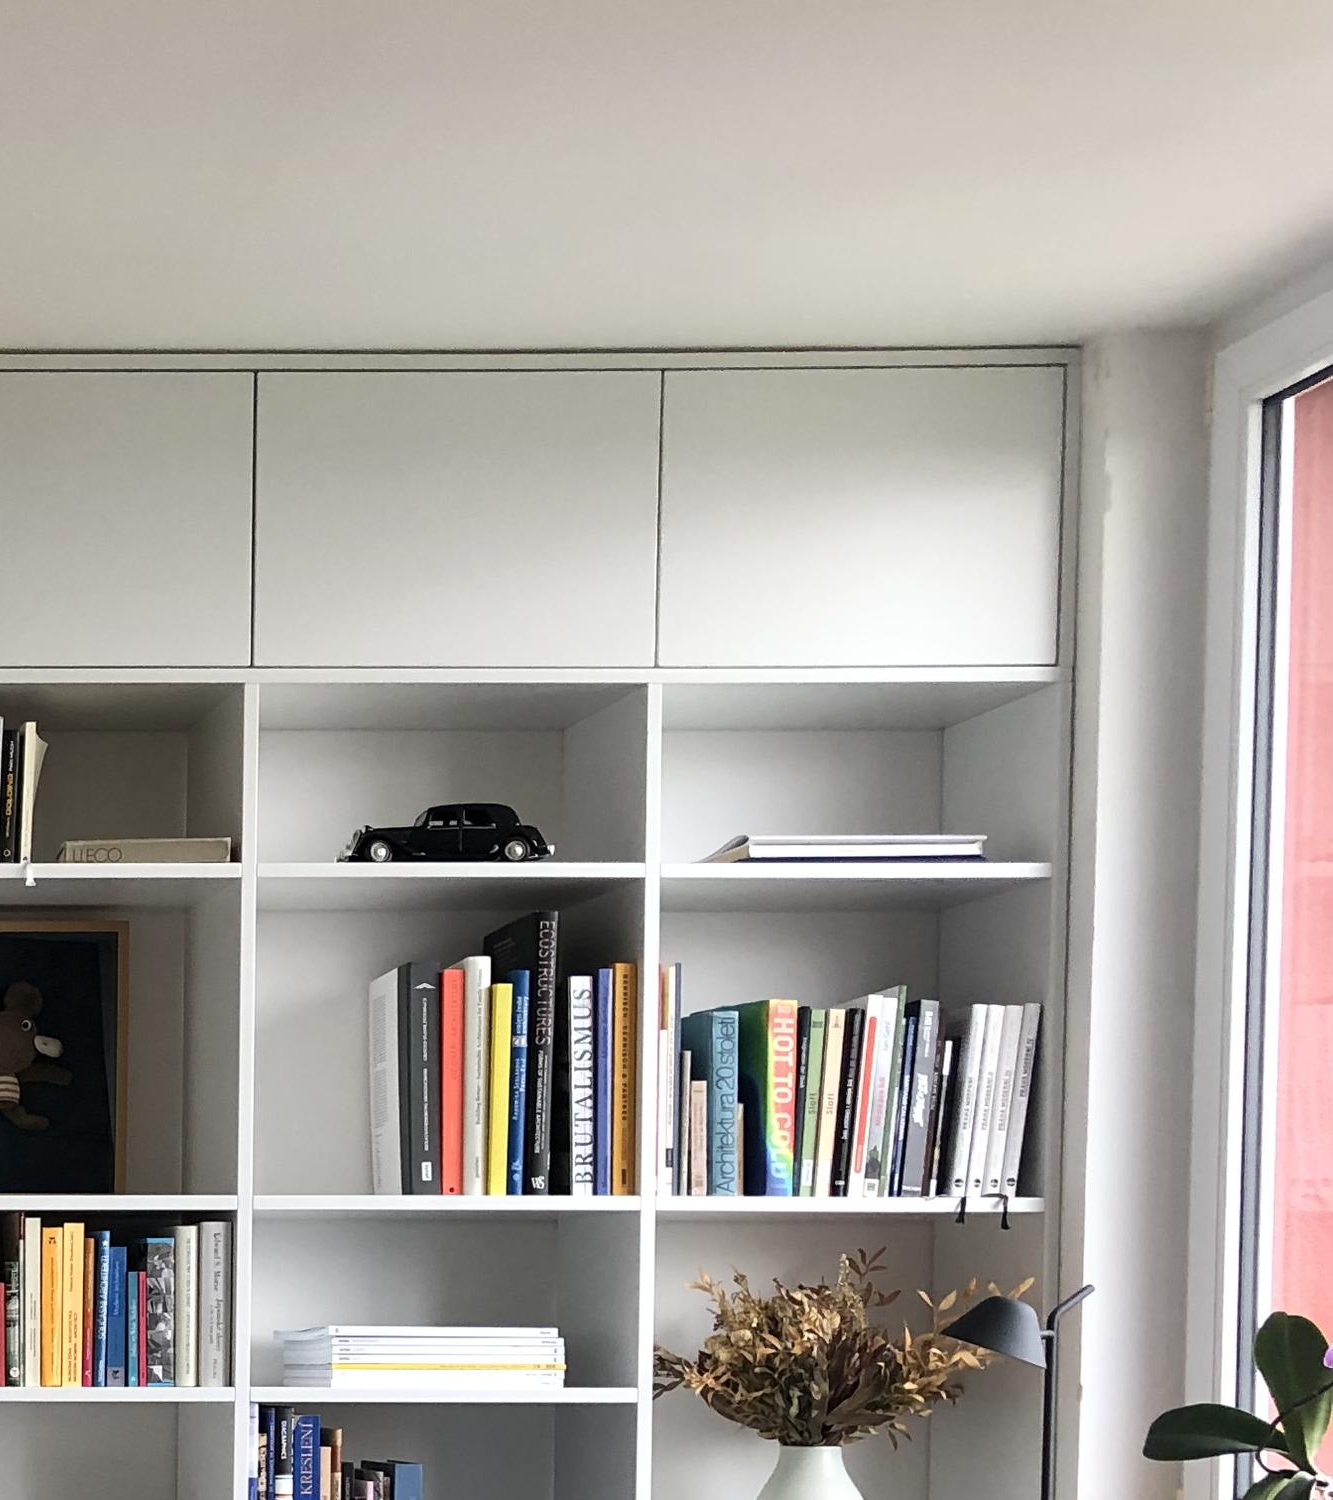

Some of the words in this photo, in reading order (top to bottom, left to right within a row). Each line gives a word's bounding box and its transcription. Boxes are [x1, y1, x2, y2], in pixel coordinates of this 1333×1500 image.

[535, 921, 556, 1045] ECOSTRUCTURES
[717, 1017, 736, 1065] století
[773, 1017, 794, 1067] HOT
[1022, 1046, 1031, 1074] MODERNÍ
[572, 989, 593, 1184] BRUTALISMUS
[716, 1066, 735, 1089] 20
[773, 1072, 793, 1103] TO
[1019, 1076, 1027, 1097] PRAHA
[534, 1114, 542, 1154] ARCHITECTURE
[715, 1091, 735, 1193] Architektura
[771, 1112, 791, 1179] COLD
[298, 1422, 313, 1495] KRESLENÍ
